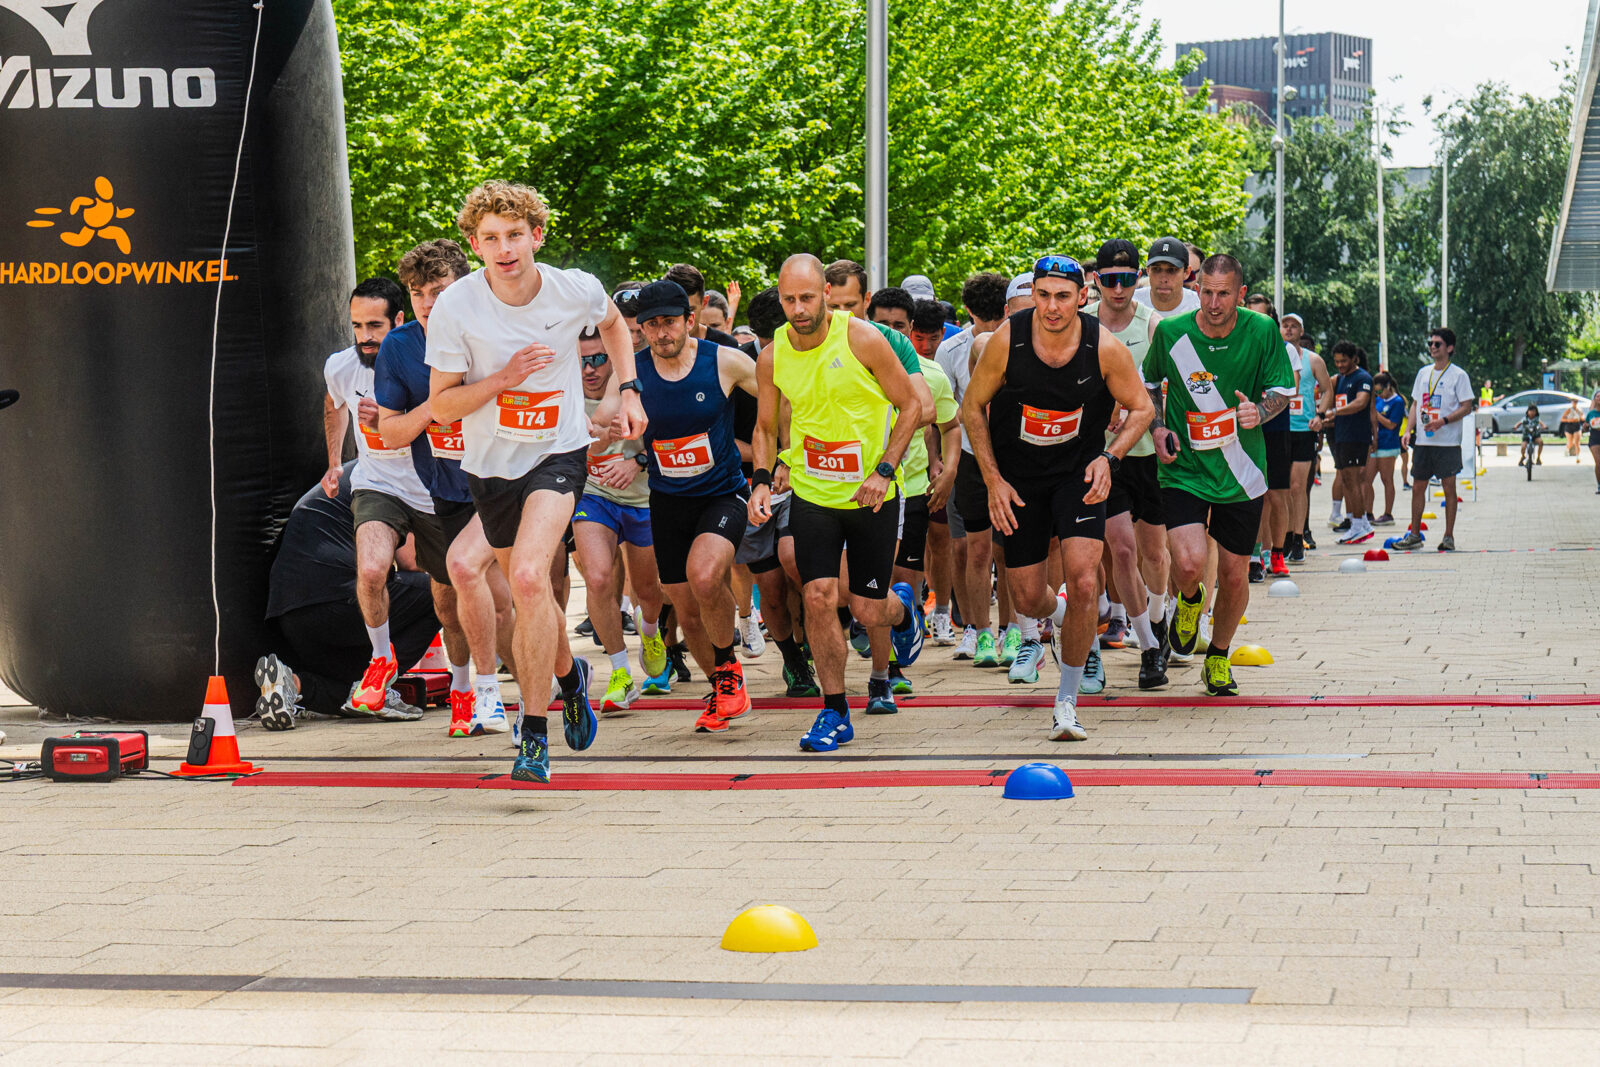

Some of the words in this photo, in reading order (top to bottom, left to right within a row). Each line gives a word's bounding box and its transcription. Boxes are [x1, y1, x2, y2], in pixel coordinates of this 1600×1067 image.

[517, 411, 546, 427] 174
[1041, 423, 1062, 435] 76
[1202, 425, 1221, 438] 54
[668, 452, 696, 466] 149
[817, 455, 845, 470] 201
